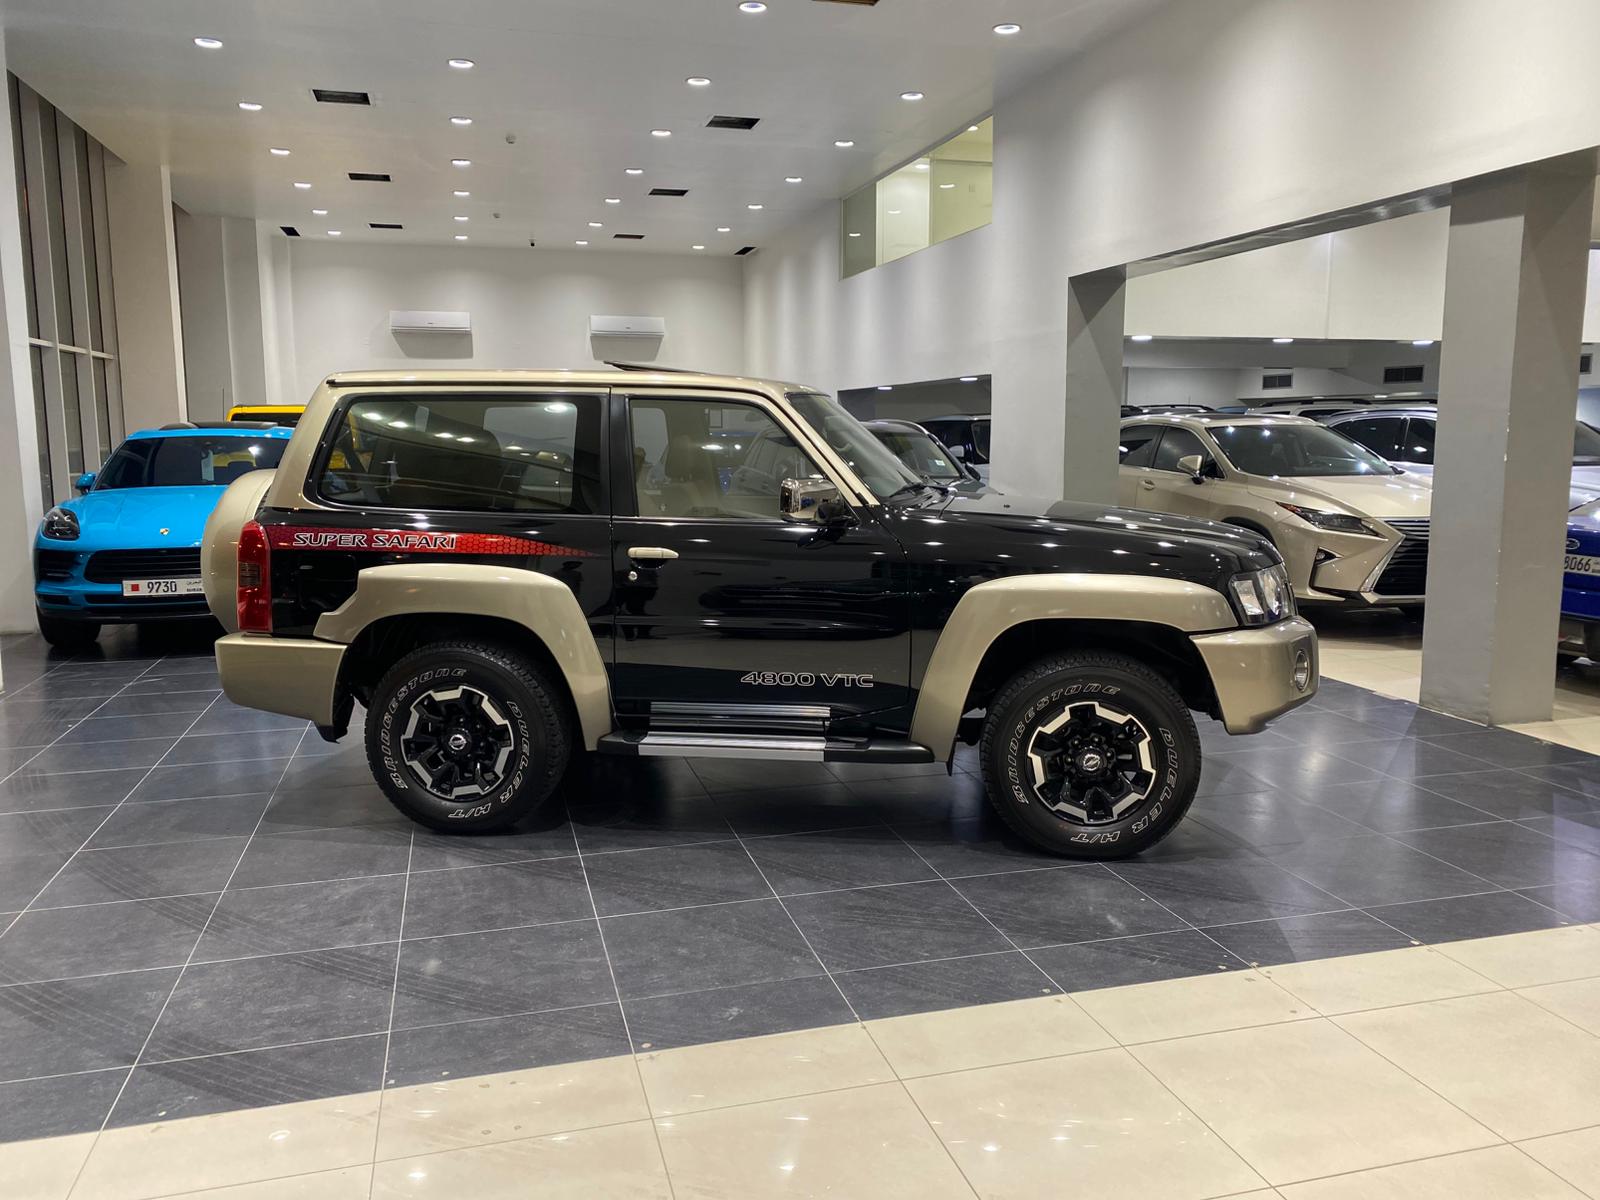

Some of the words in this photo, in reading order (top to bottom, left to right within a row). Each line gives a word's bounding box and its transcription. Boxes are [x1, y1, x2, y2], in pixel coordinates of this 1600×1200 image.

[293, 532, 367, 547] SUPER
[372, 533, 456, 550] SAFARI
[147, 581, 177, 593] 9730
[741, 672, 815, 687] 4800
[820, 673, 874, 687] VTC
[381, 668, 467, 790] BRIDGESTONE
[500, 701, 530, 803] DUELER
[1007, 683, 1121, 805] BRIDGESTONE
[1131, 728, 1178, 833] DUELER
[448, 803, 492, 818] H/T
[1070, 831, 1121, 844] H/T
